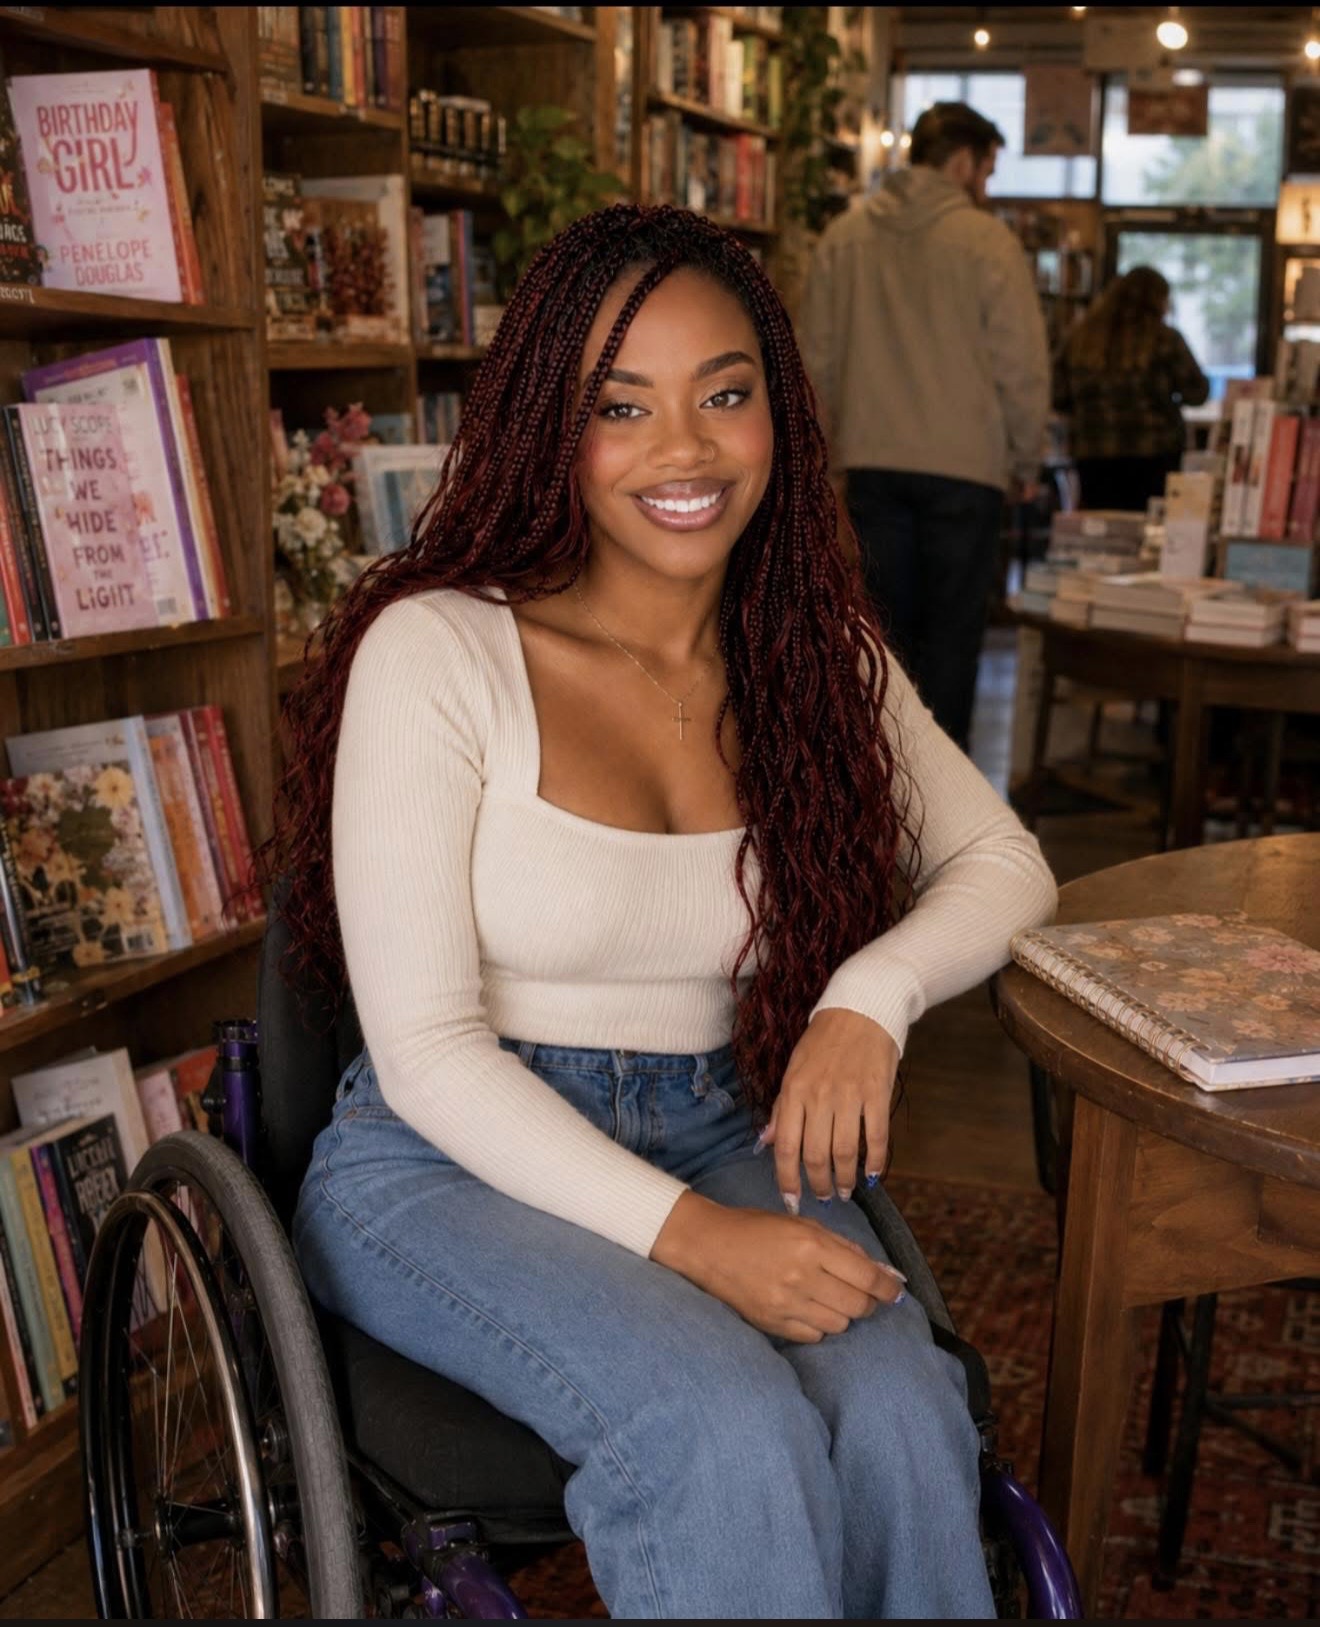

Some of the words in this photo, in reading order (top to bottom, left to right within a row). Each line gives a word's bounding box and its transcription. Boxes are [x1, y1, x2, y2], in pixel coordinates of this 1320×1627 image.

[36, 101, 138, 167] BIRTHDAY
[60, 239, 152, 263] PENELOPE
[75, 262, 144, 287] DOUGLAS
[39, 447, 117, 472] THINGS
[70, 480, 102, 501] WE
[65, 510, 117, 535] HIDE
[72, 544, 126, 568] FROM
